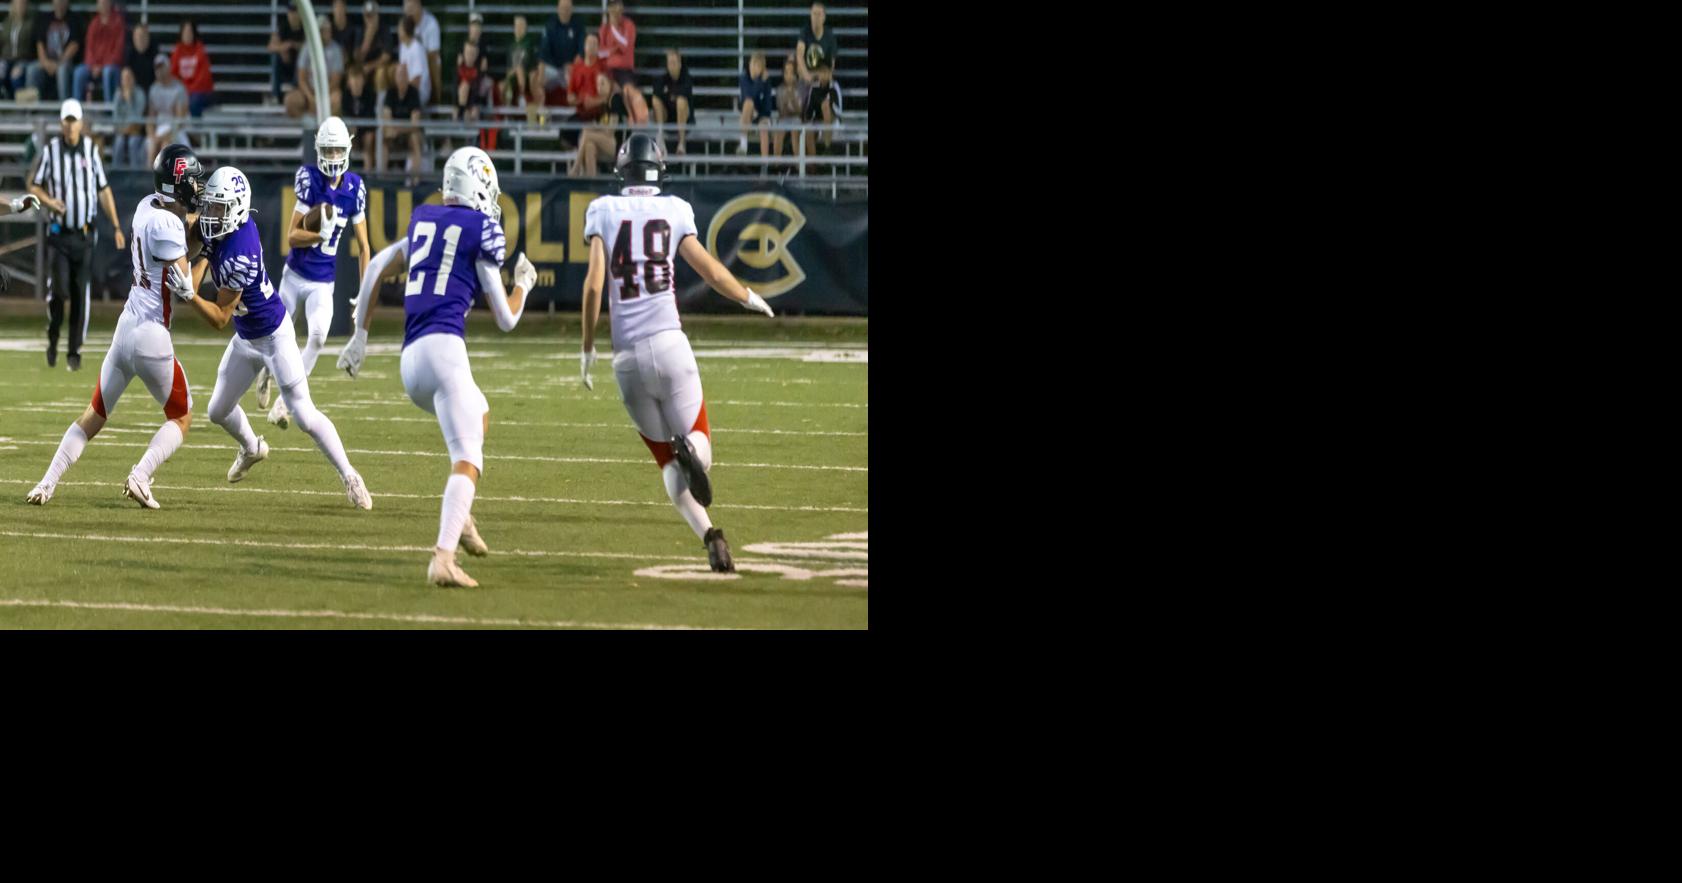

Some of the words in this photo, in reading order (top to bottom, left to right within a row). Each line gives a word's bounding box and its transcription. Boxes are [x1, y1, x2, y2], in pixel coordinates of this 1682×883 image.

[231, 175, 246, 193] 29
[405, 221, 462, 296] 21
[611, 219, 672, 300] 48
